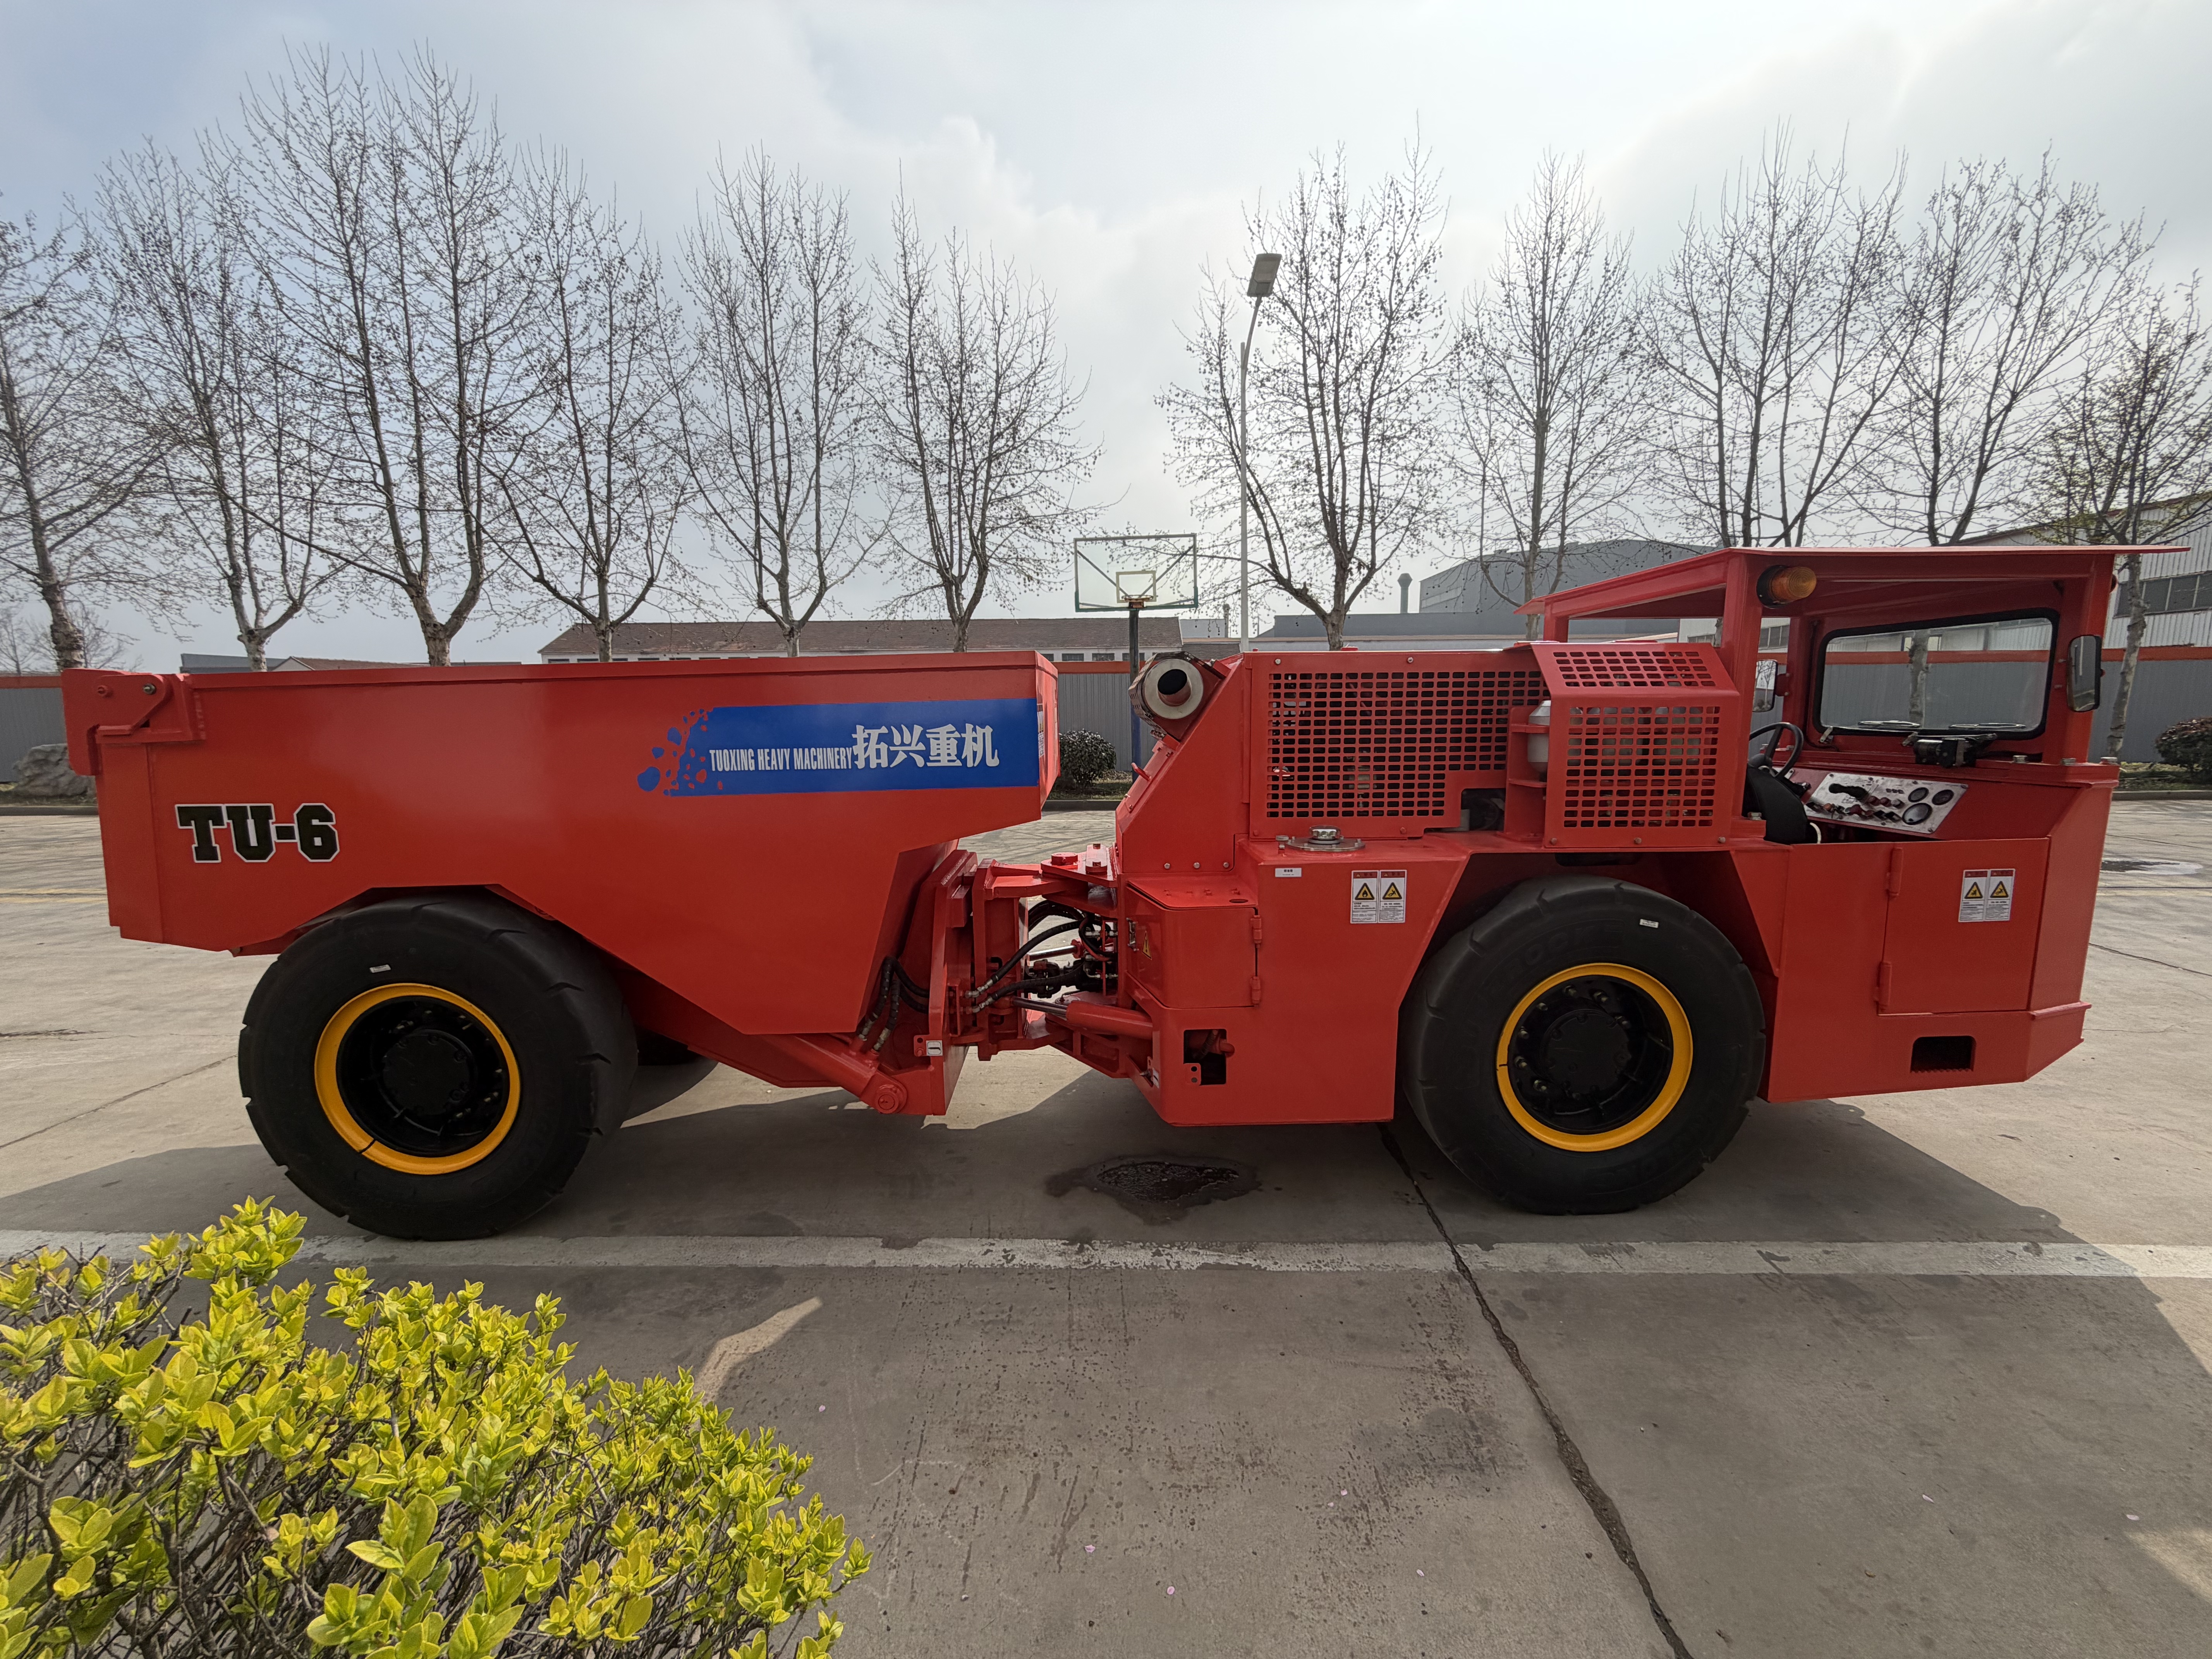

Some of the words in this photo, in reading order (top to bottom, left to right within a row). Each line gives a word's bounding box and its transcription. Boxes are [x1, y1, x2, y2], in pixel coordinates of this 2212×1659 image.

[709, 749, 755, 771] TUOXING
[757, 748, 790, 770] HEAVY
[793, 747, 852, 770] MACHINERY
[852, 723, 1000, 769] 拓兴重机
[175, 803, 340, 863] TU-6
